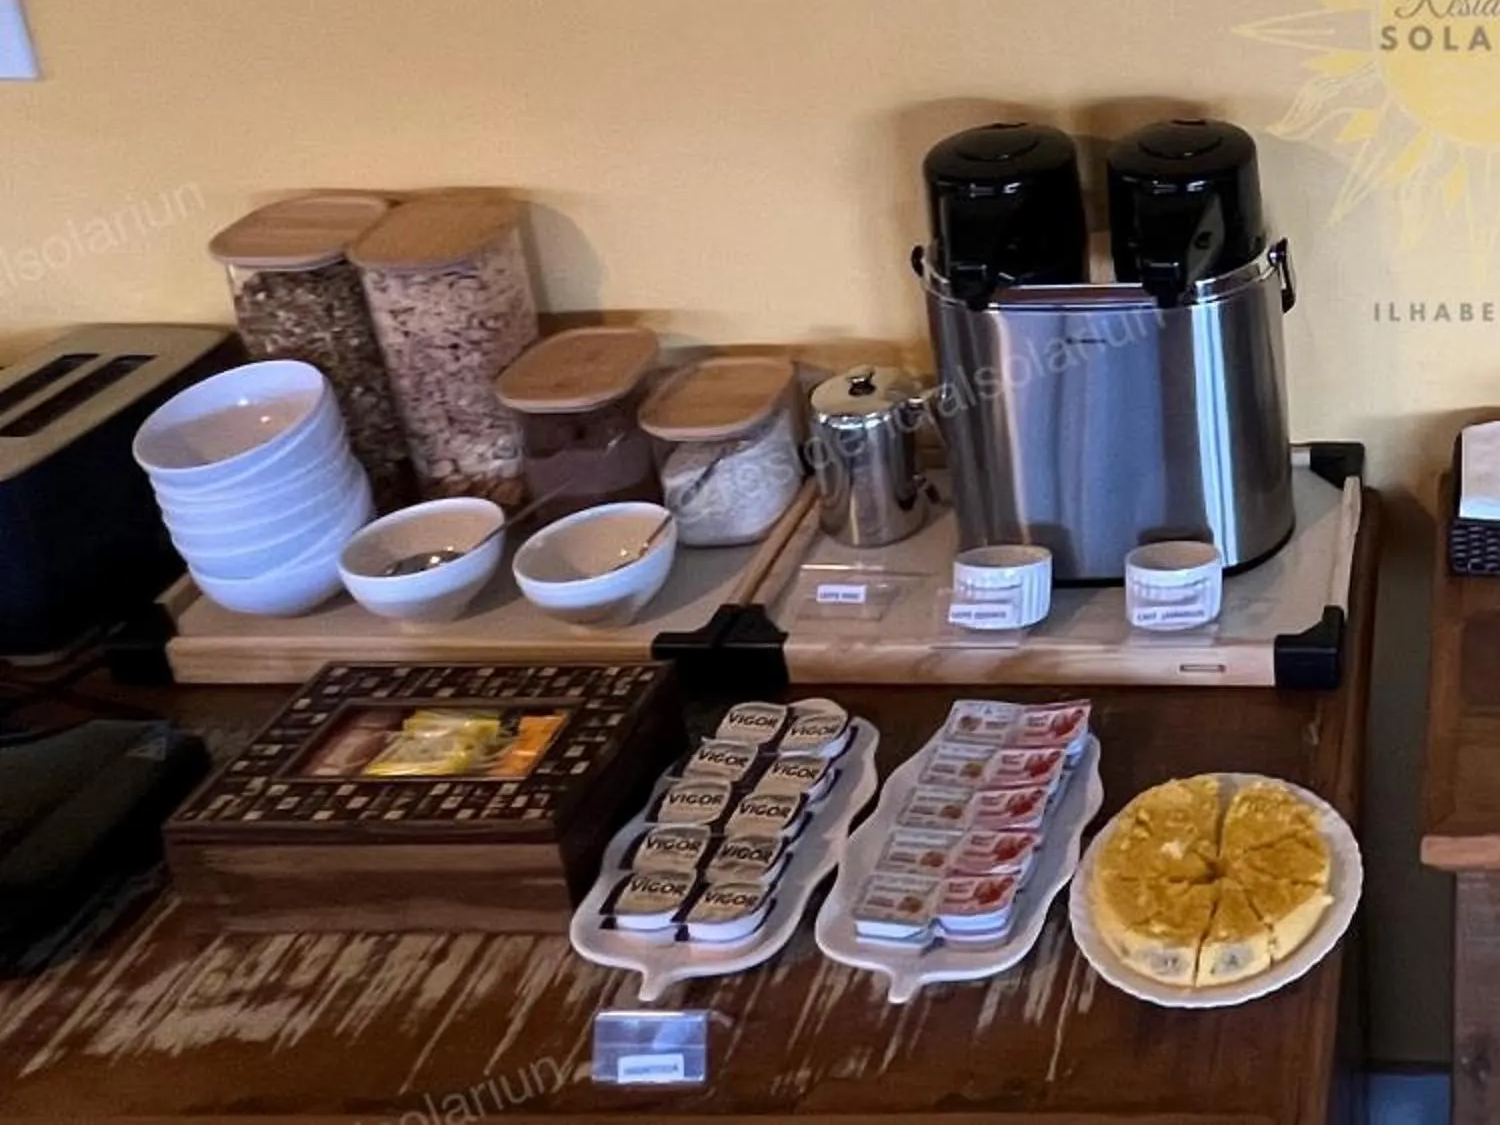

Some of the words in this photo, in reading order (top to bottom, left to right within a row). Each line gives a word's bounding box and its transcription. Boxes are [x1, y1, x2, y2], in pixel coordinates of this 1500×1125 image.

[727, 713, 779, 728] VIGOR
[790, 725, 837, 736] VIGOR
[698, 749, 749, 766] VIGOR
[772, 763, 821, 779] VIGOR
[668, 794, 724, 805] VIGOR
[739, 803, 792, 817] VIGOR
[645, 839, 701, 852] VIGOR
[721, 844, 773, 862] VIGOR
[630, 879, 688, 895] VIGOR
[704, 893, 759, 907] VIGOR
